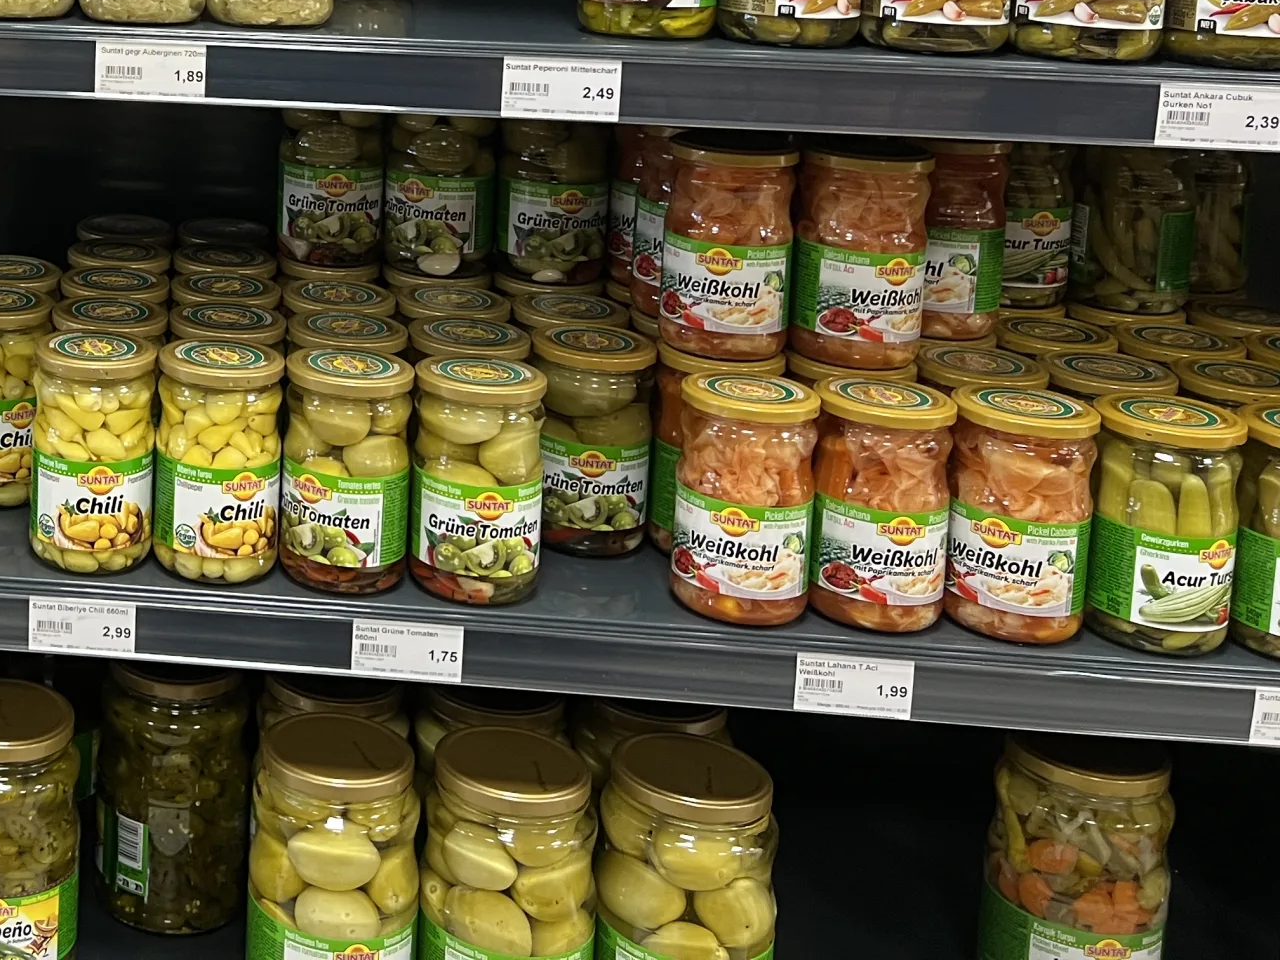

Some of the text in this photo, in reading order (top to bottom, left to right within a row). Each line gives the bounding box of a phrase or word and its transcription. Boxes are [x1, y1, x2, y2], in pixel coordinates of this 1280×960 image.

[174, 70, 203, 83] 1,89
[533, 65, 568, 74] Peperoni
[571, 66, 617, 75] Mittelscharf
[583, 87, 613, 101] 2,49
[1164, 91, 1253, 102] Suntat Ankara Cubuk
[1163, 101, 1194, 109] Gurken
[1245, 115, 1279, 131] 2,39
[319, 178, 355, 191] SUNTAT
[288, 195, 379, 214] Grüne Tomaten
[406, 205, 467, 222] Tomaten
[517, 212, 562, 230] Grüne
[677, 271, 761, 300] Weißkohl
[79, 473, 121, 487] SUNTAT
[582, 478, 644, 497] Tomaten
[76, 494, 124, 516] Chili
[220, 499, 265, 522] Chili
[468, 499, 511, 512] SUNTAT
[300, 510, 371, 531] Tomaten
[428, 512, 538, 541] Grüne Tomaten
[880, 525, 923, 538] SUNTAT
[691, 530, 780, 564] Weißkohl
[851, 543, 938, 570] Weißkohl
[951, 537, 1043, 579] Weißkohl
[1162, 571, 1208, 589] Acur
[32, 603, 56, 611] Suntat
[88, 607, 105, 615] Chili
[103, 626, 131, 639] 2,99
[356, 625, 439, 637] Suntat Grüne Tomaten
[428, 650, 458, 664] 1,75
[877, 685, 908, 699] 1,99
